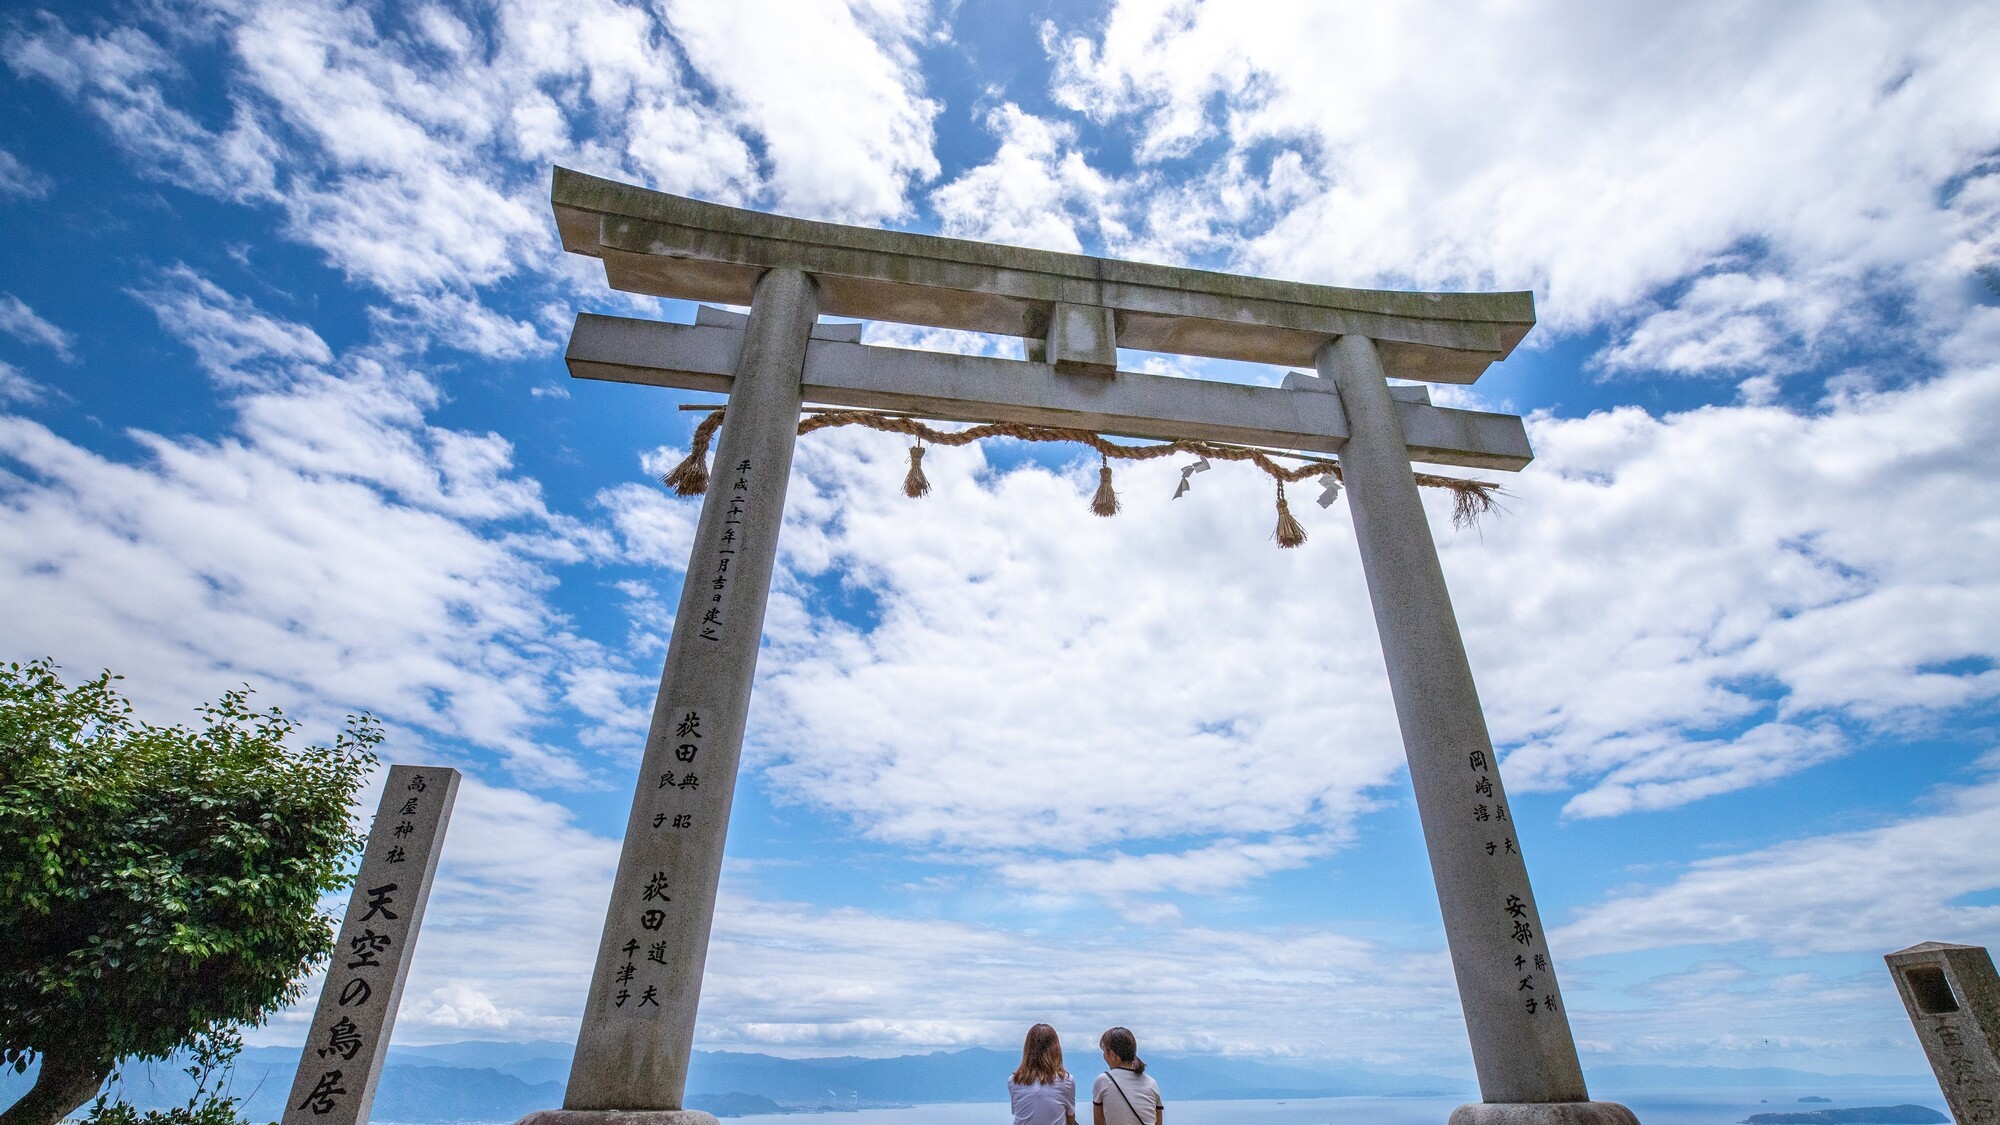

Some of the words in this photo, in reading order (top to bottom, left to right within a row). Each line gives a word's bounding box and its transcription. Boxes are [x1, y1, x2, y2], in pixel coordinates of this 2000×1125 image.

[384, 774, 427, 864] 高屋神社
[298, 883, 399, 1116] 天空の鳥居
